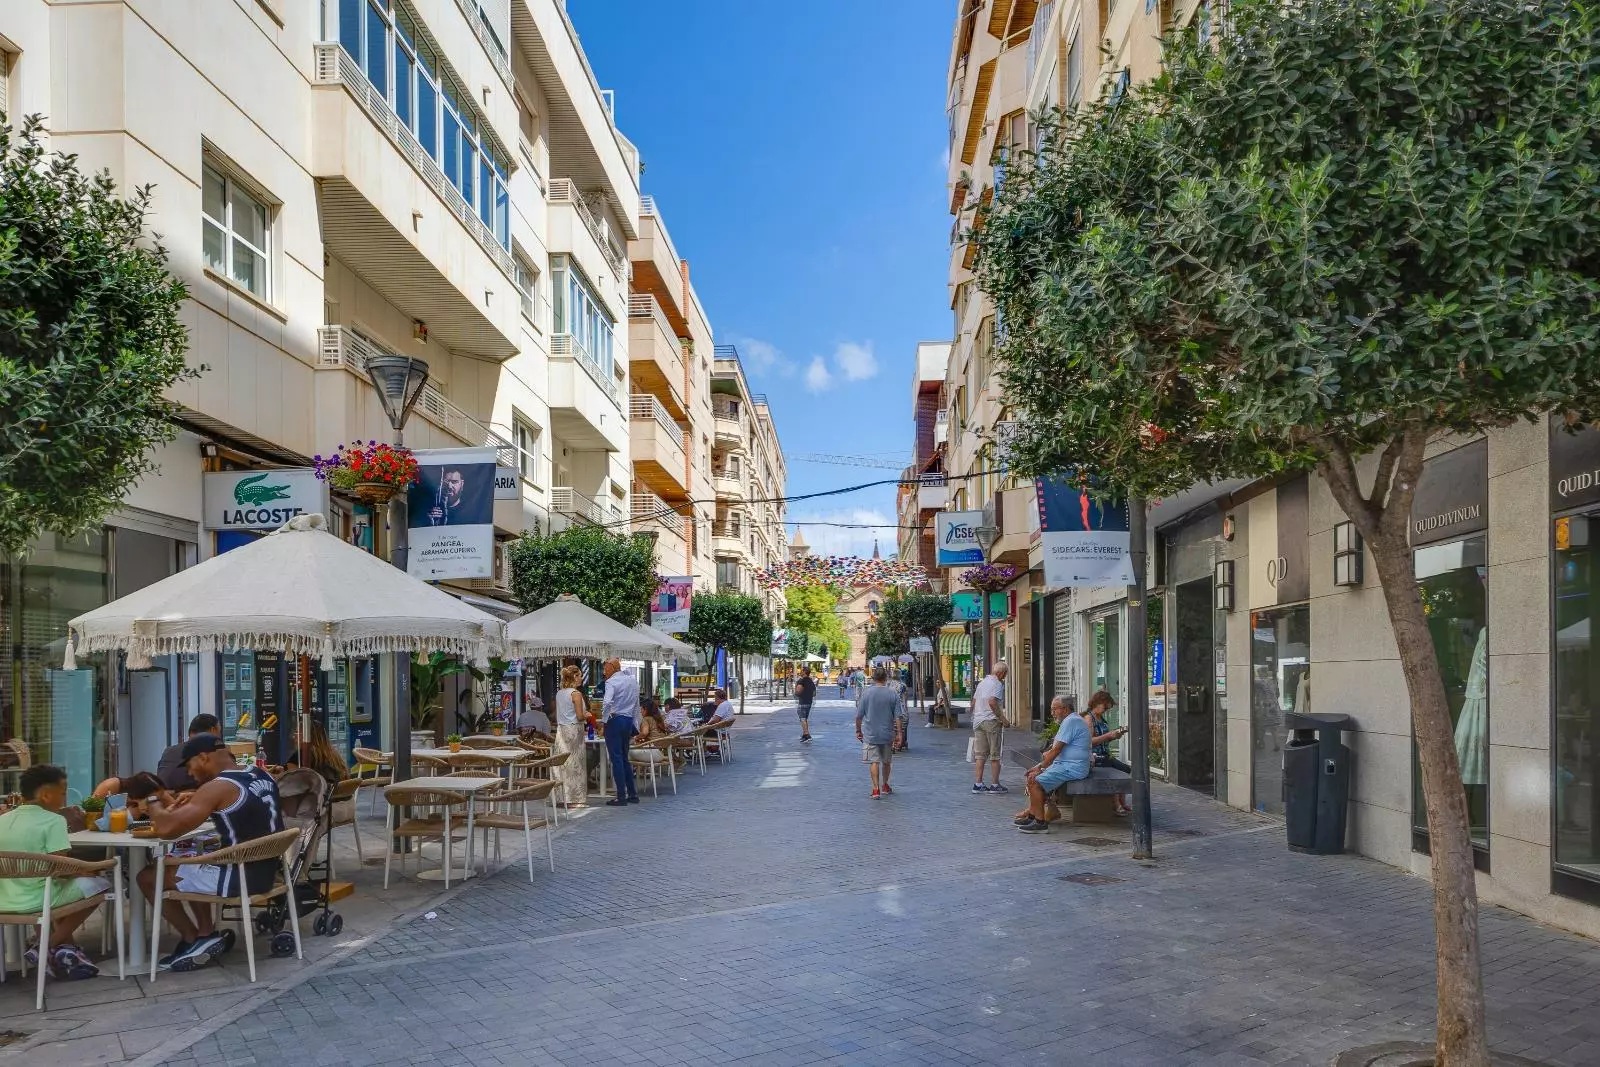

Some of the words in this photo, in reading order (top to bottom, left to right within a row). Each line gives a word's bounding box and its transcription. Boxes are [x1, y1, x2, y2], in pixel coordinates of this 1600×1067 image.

[1557, 473, 1592, 497] QUID
[1415, 516, 1437, 535] QUID
[1438, 504, 1481, 527] DIVINUM
[1052, 546, 1093, 554] SIDECARS:
[1093, 546, 1122, 554] EVEREST
[261, 795, 278, 832] 7
